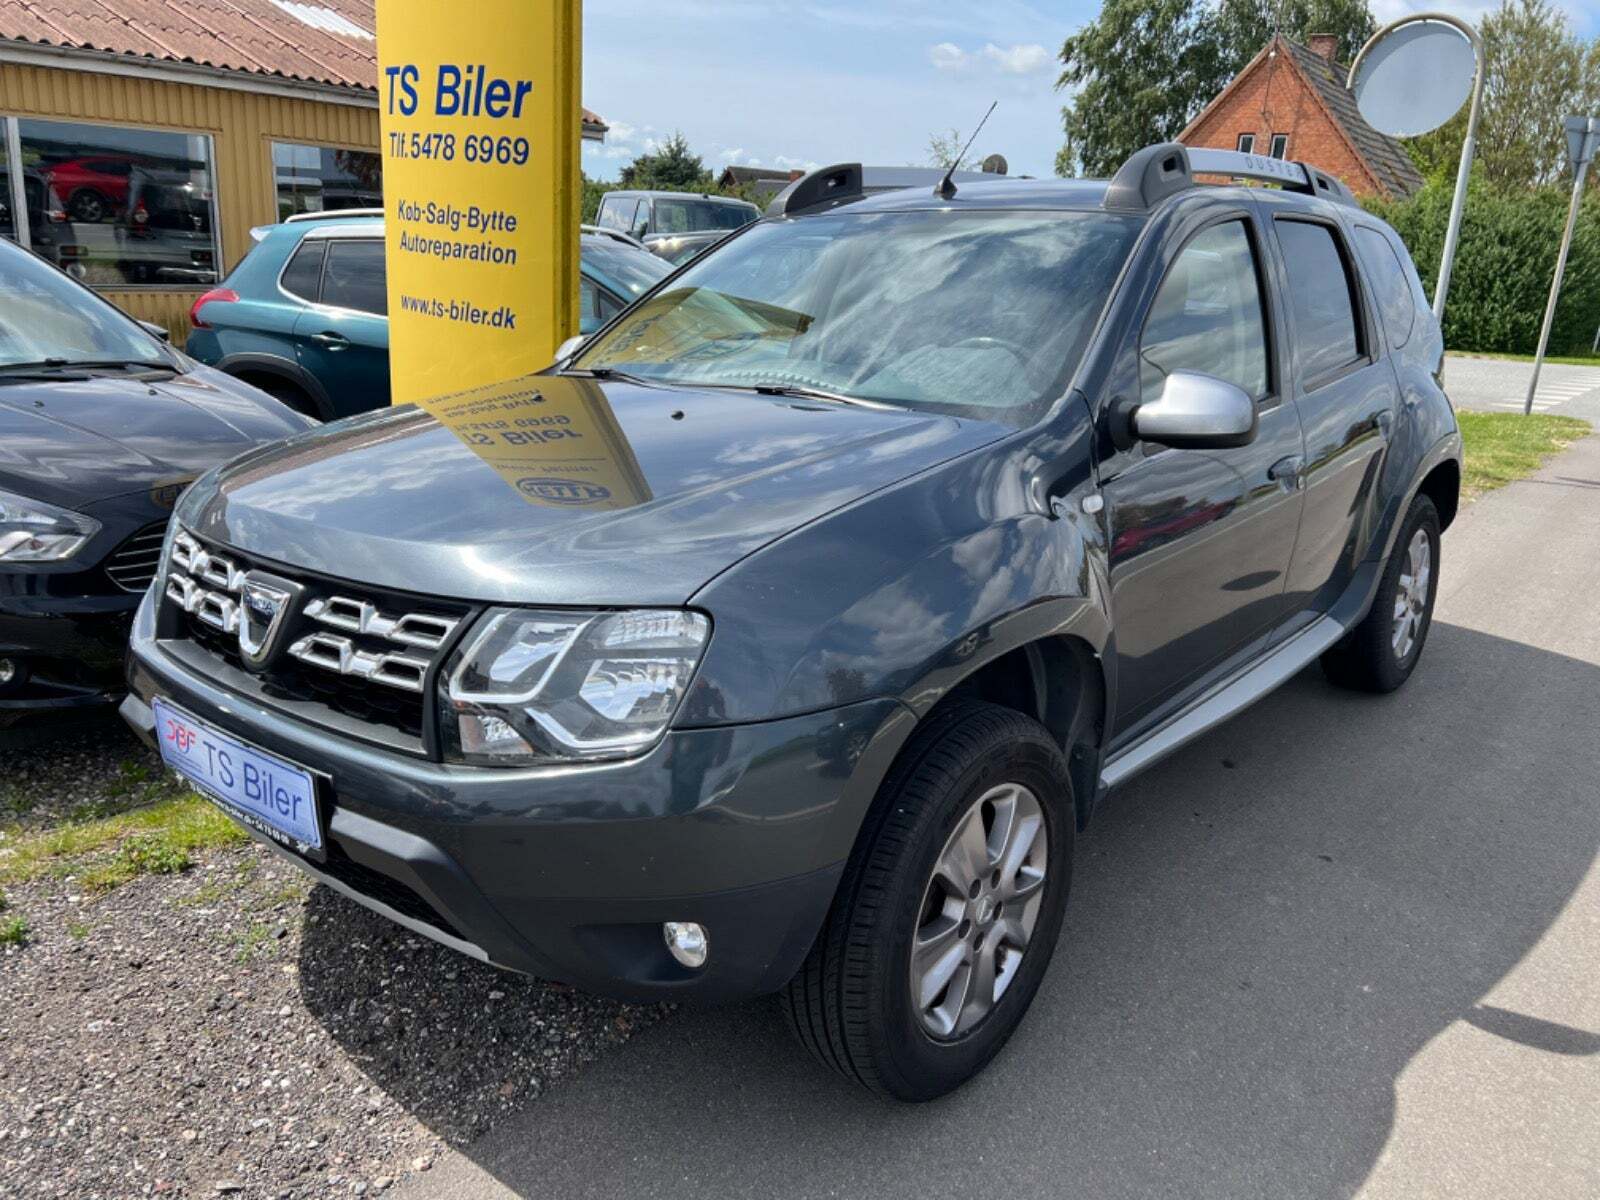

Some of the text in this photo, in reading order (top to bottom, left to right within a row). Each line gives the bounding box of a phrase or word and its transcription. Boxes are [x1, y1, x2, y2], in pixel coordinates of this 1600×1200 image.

[385, 64, 533, 118] TS Biler
[464, 134, 530, 166] 6969
[400, 230, 517, 265] Autoreparation
[400, 294, 516, 330] www.ts-biler.dk
[202, 740, 235, 788] TS
[243, 761, 303, 821] Biler
